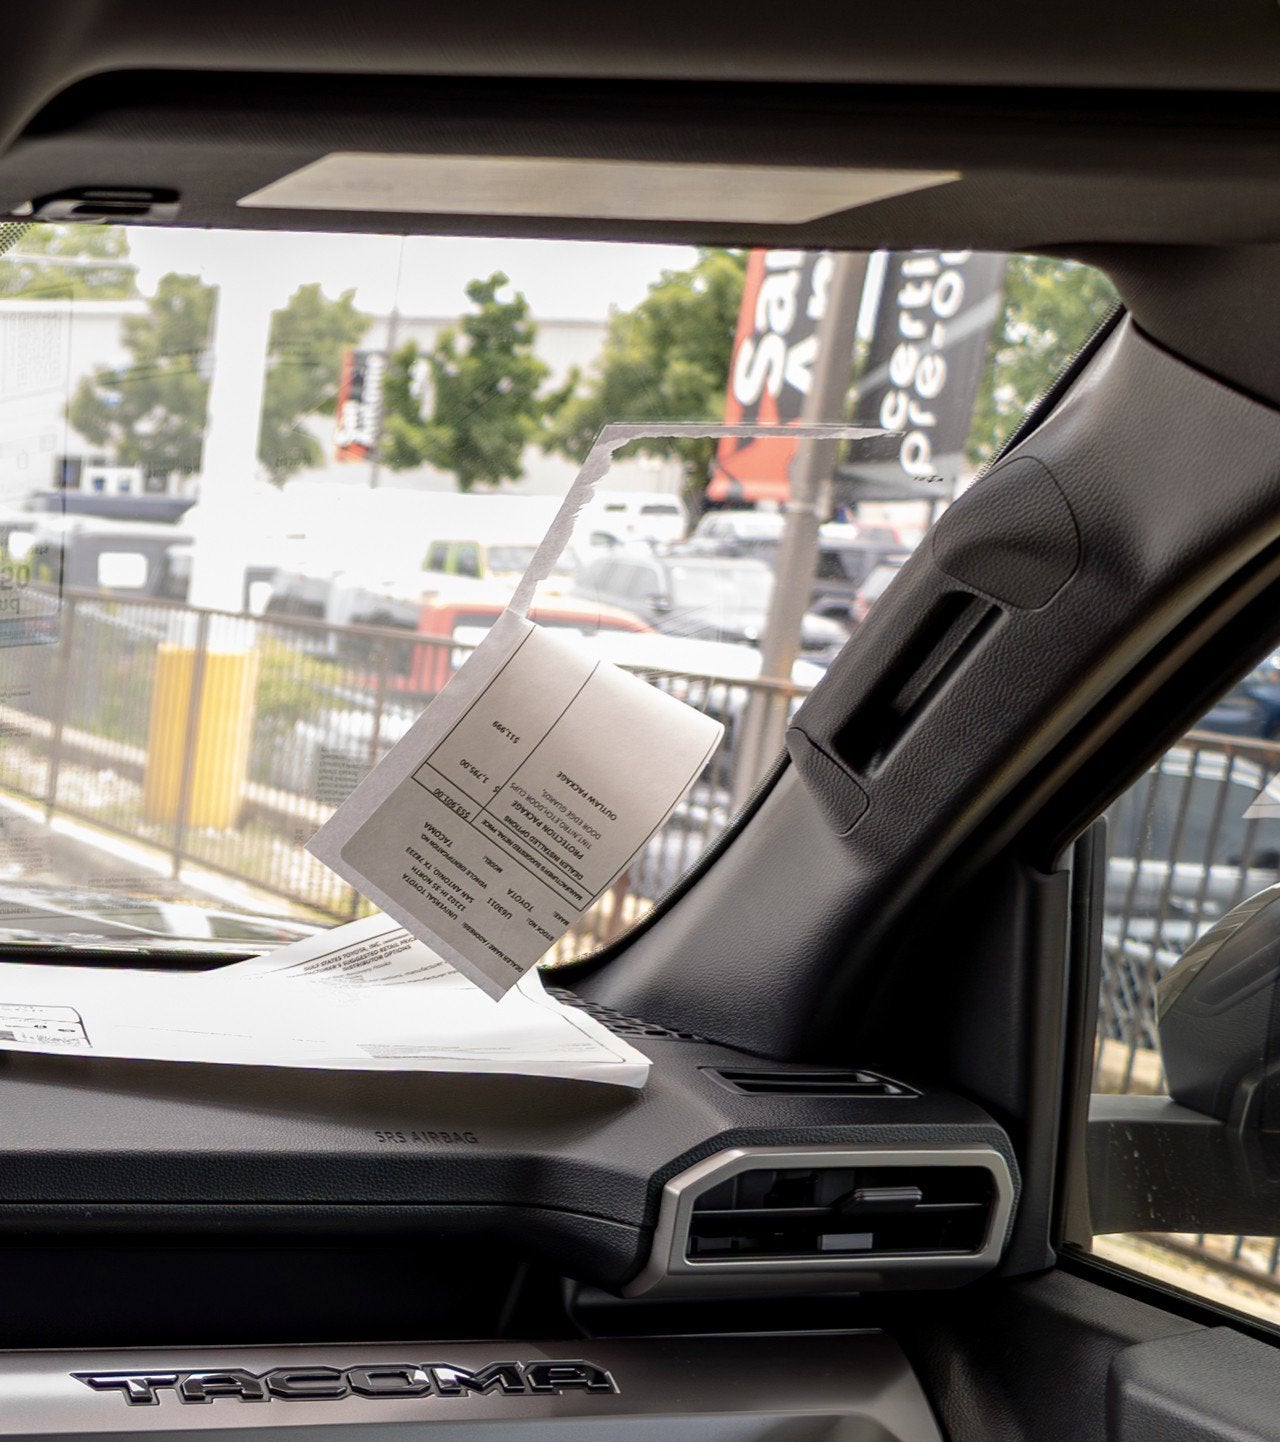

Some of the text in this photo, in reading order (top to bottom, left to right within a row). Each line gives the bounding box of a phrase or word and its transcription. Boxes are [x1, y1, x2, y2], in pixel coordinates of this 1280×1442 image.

[492, 720, 520, 744] $11,999
[511, 800, 584, 860] PROTECTION PACKAGE
[402, 873, 458, 920] UNIVERSAL TOYOTA
[405, 846, 475, 903] SAN ANTONIO, TX 78233
[411, 867, 466, 911] 12102 IH-35 NORTH
[375, 1131, 479, 1144] SRS AIRBAG
[70, 1359, 624, 1406] TACOMA
